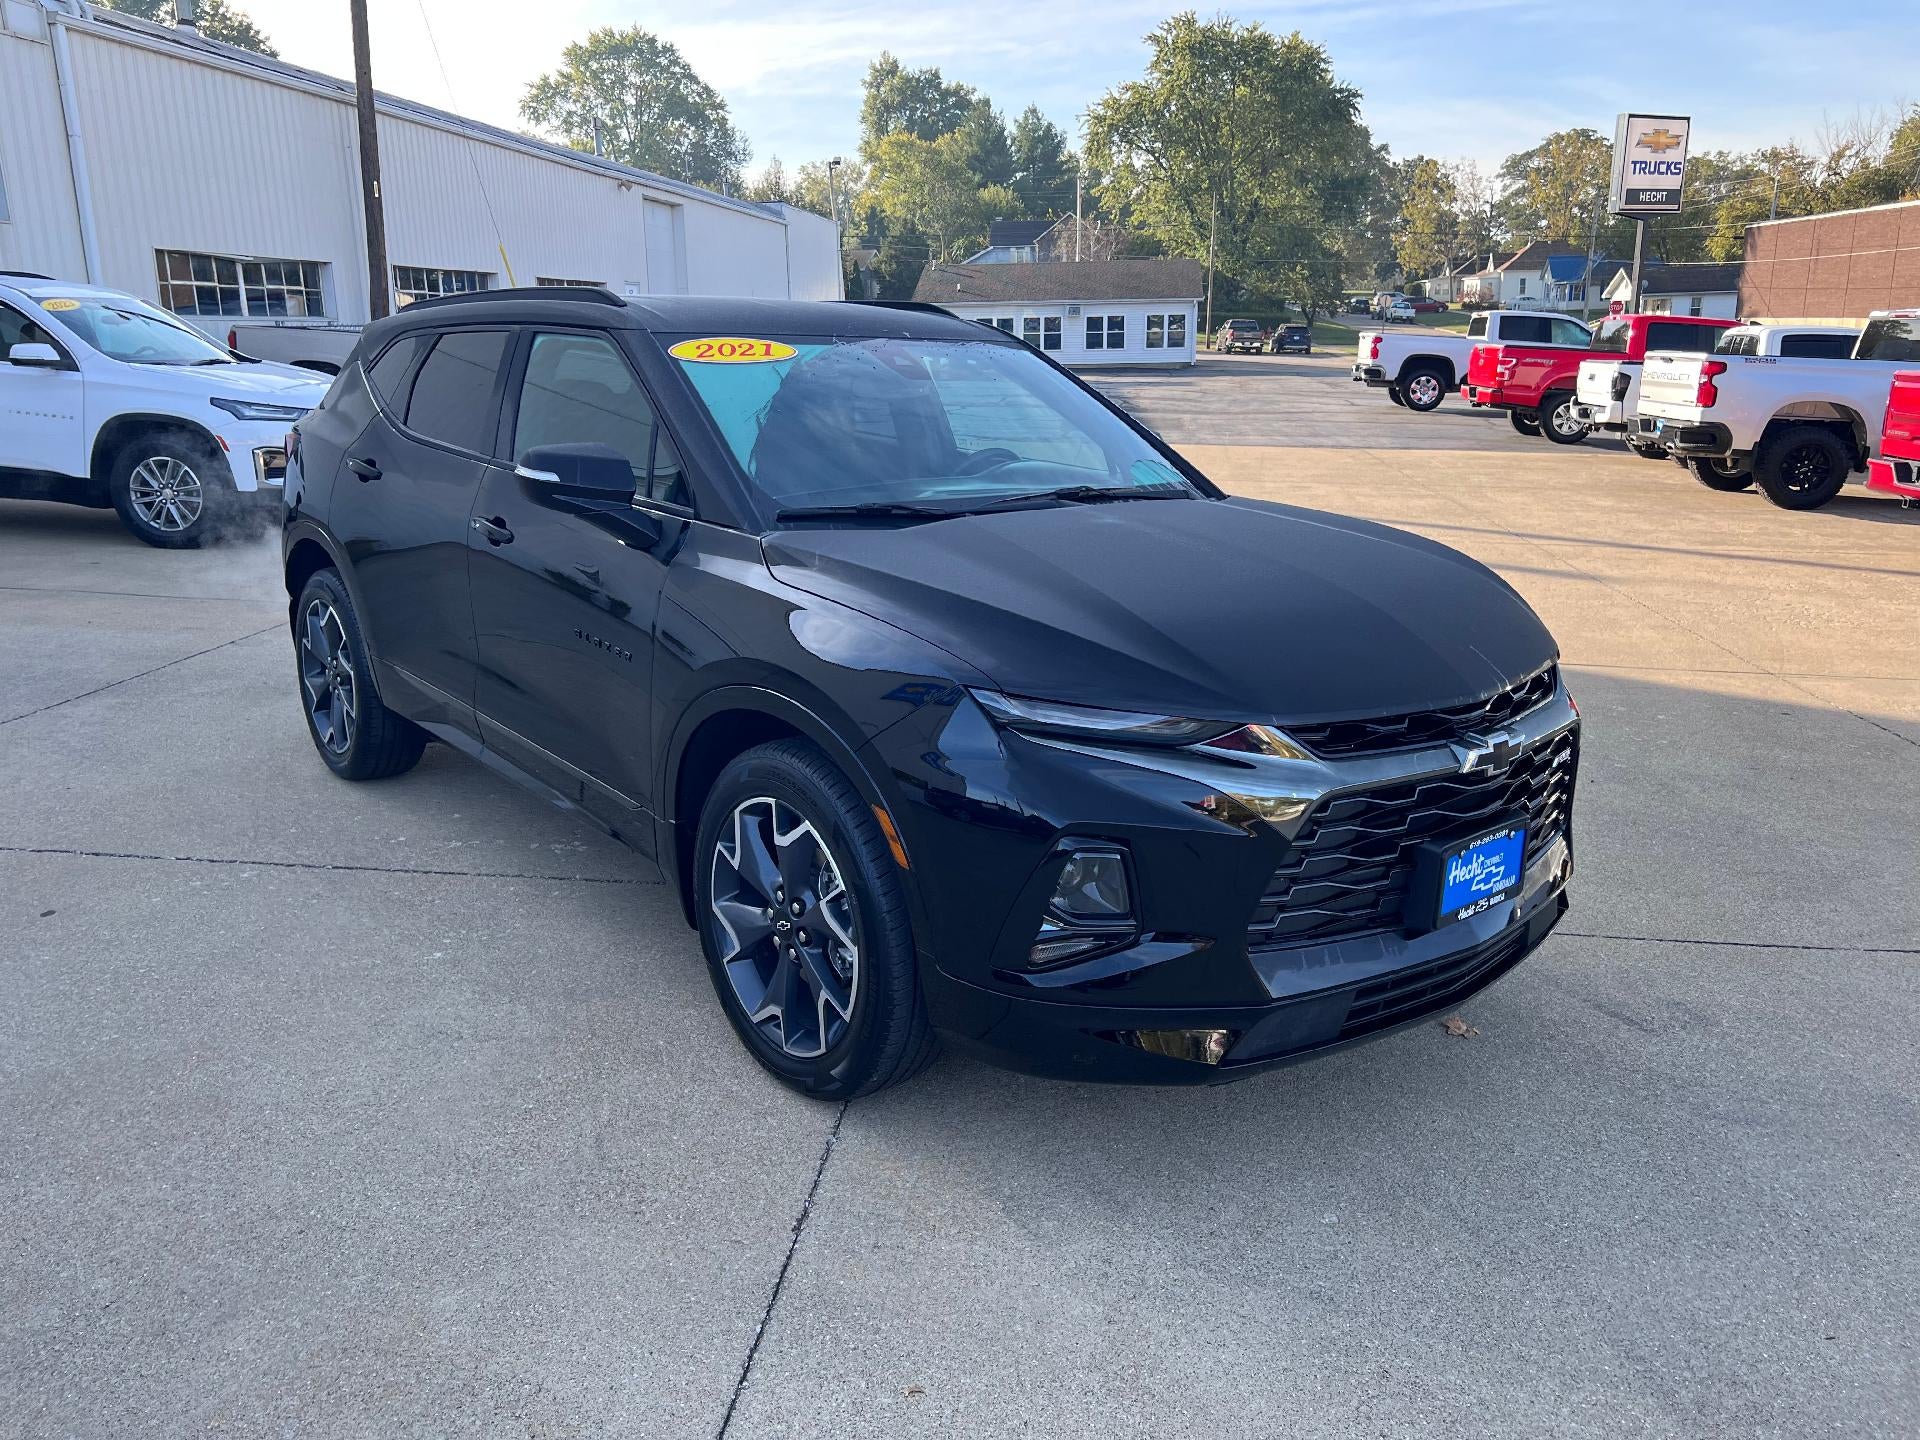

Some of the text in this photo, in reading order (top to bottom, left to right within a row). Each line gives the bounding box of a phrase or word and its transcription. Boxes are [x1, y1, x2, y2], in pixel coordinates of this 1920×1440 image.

[1631, 161, 1682, 175] TRUCKS
[1640, 192, 1667, 202] HECHT
[695, 343, 775, 358] 2021
[1449, 853, 1485, 887] Hecht
